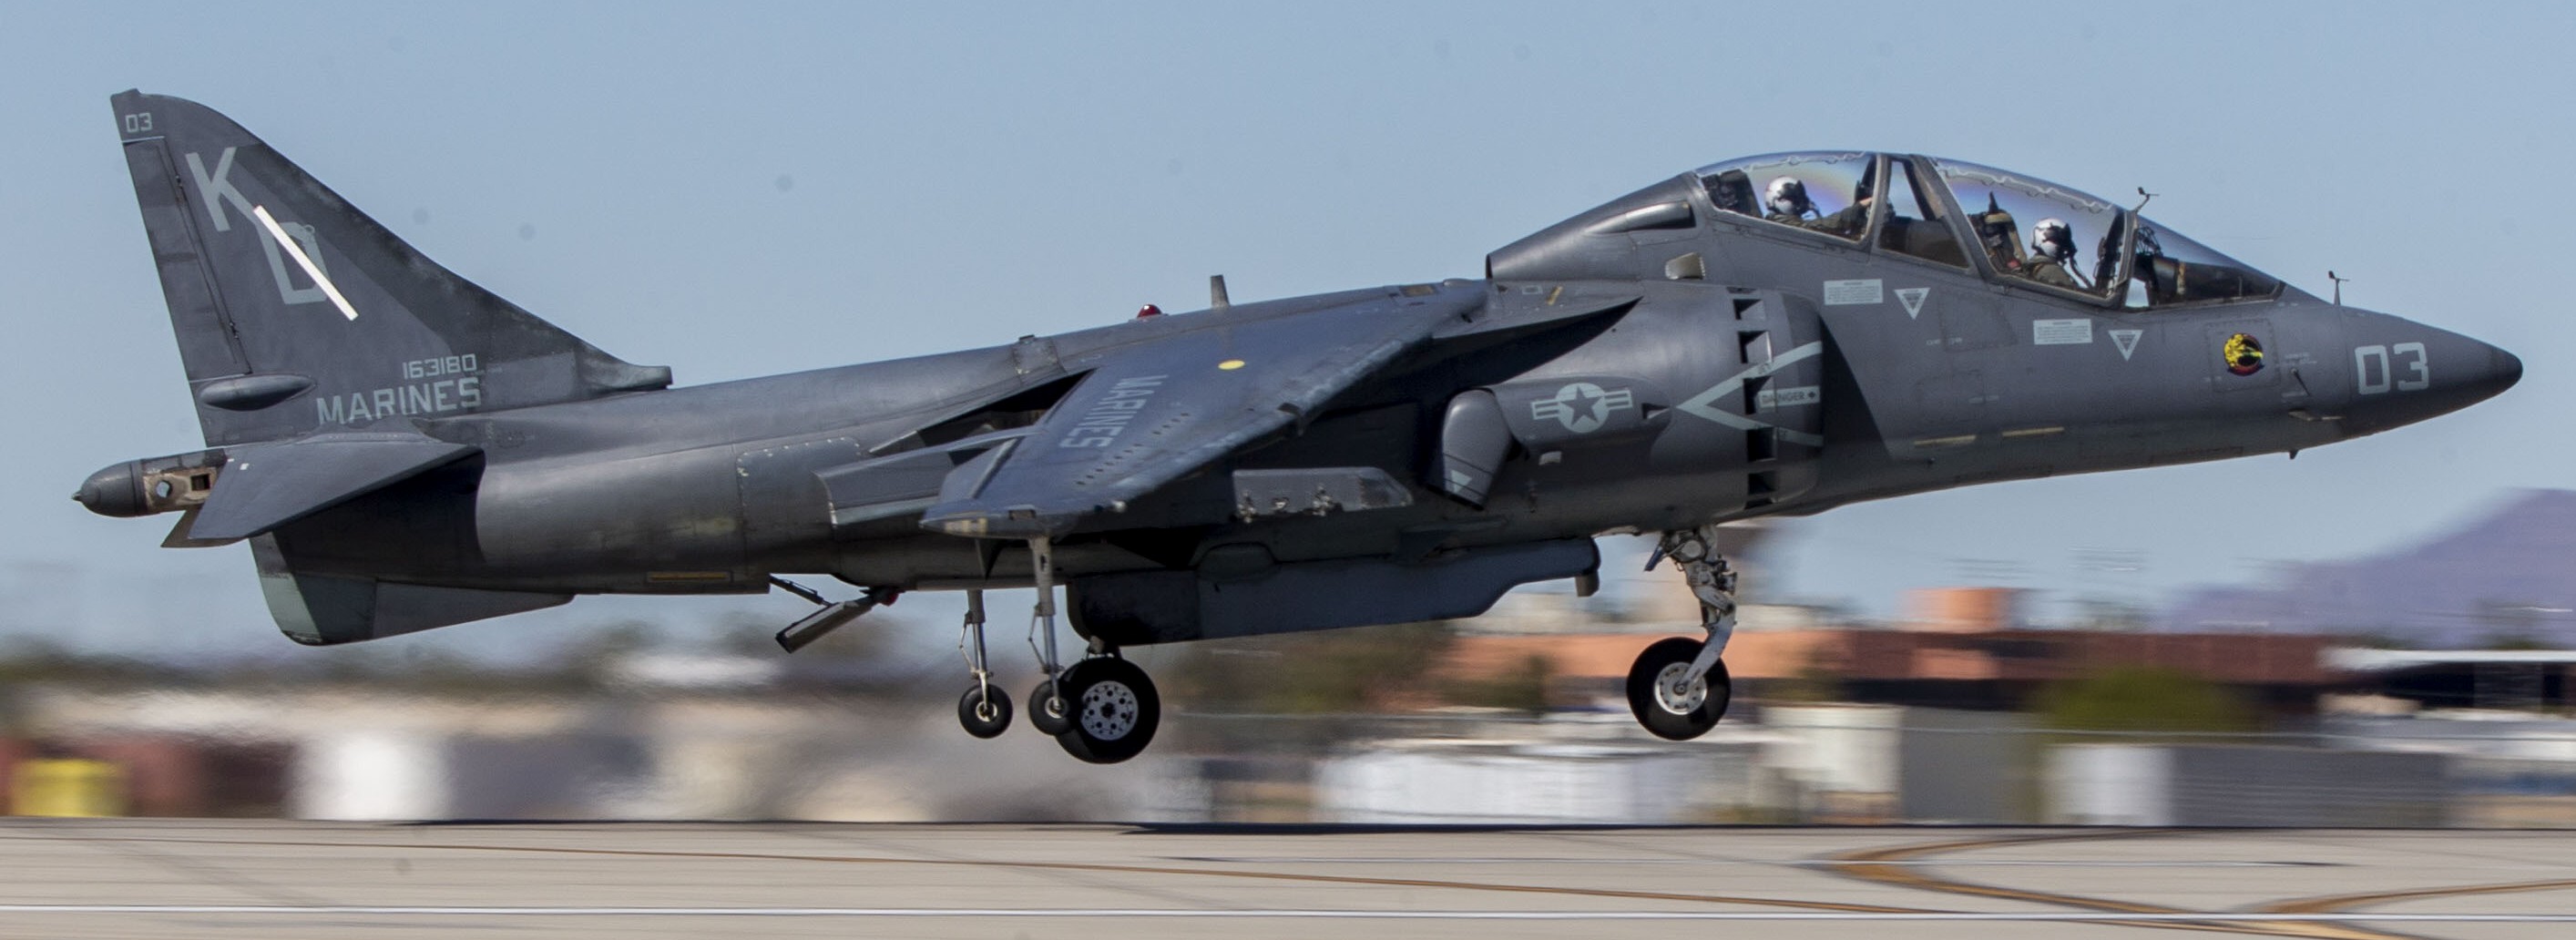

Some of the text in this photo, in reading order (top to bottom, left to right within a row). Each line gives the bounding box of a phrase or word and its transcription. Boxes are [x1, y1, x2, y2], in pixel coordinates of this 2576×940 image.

[125, 112, 153, 133] 03
[185, 146, 264, 232] K
[403, 352, 477, 380] 163180
[2355, 342, 2429, 395] 03
[316, 376, 481, 425] MARINES
[1059, 374, 1169, 447] MARINES
